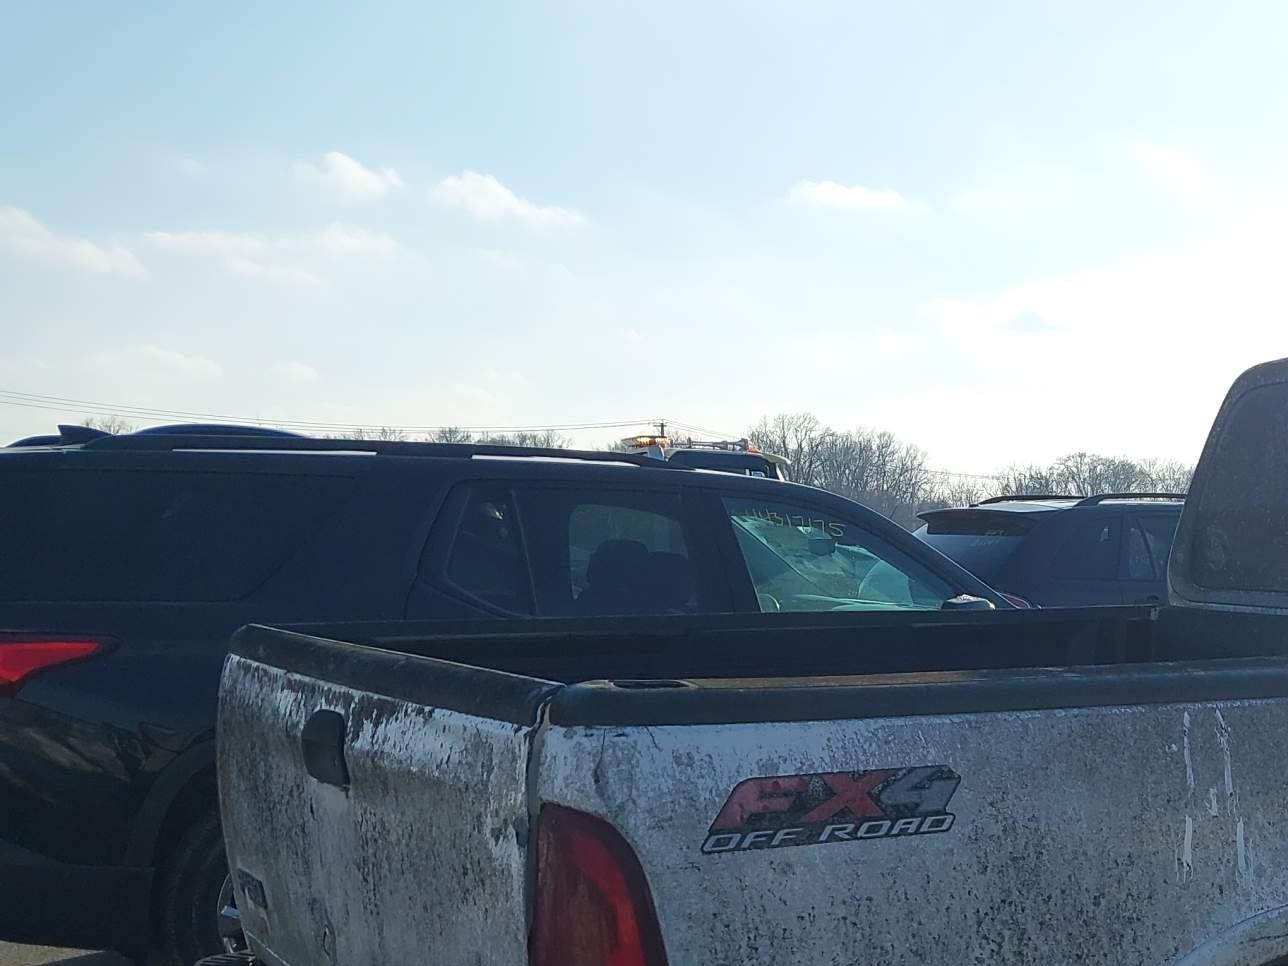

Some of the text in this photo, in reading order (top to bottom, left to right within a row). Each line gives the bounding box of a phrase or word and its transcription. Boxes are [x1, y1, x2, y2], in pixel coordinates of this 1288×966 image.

[709, 765, 960, 832] FX4
[702, 815, 954, 852] OFF ROAD
